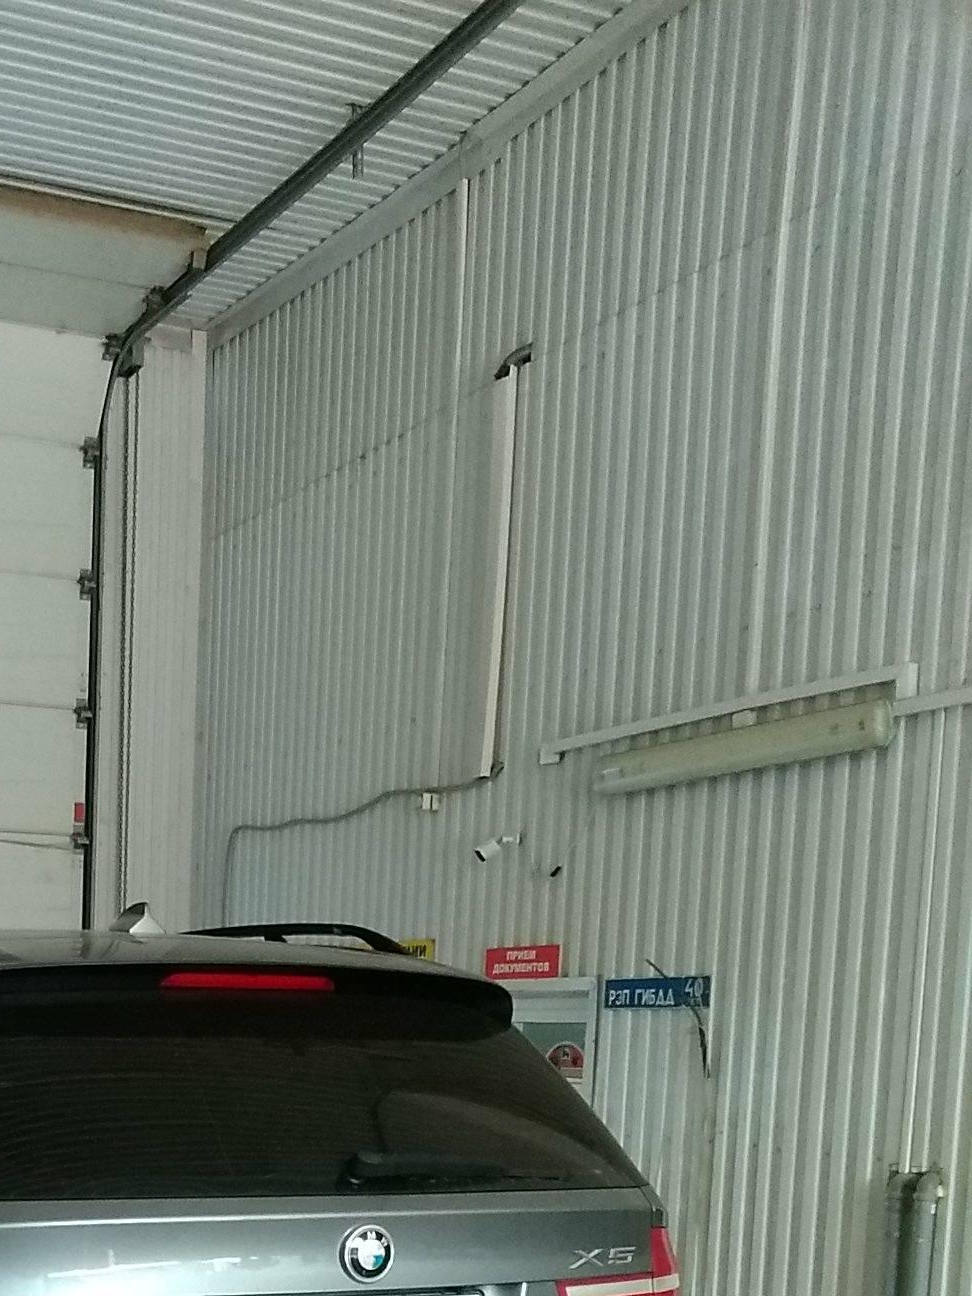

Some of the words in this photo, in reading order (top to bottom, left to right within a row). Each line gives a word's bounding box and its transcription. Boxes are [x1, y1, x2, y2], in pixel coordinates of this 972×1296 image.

[506, 949, 536, 961] ПРИЕМ
[492, 961, 550, 975] ДОКУМЕНТОВ
[634, 988, 675, 1006] ГИБДД
[569, 1246, 637, 1270] X5
